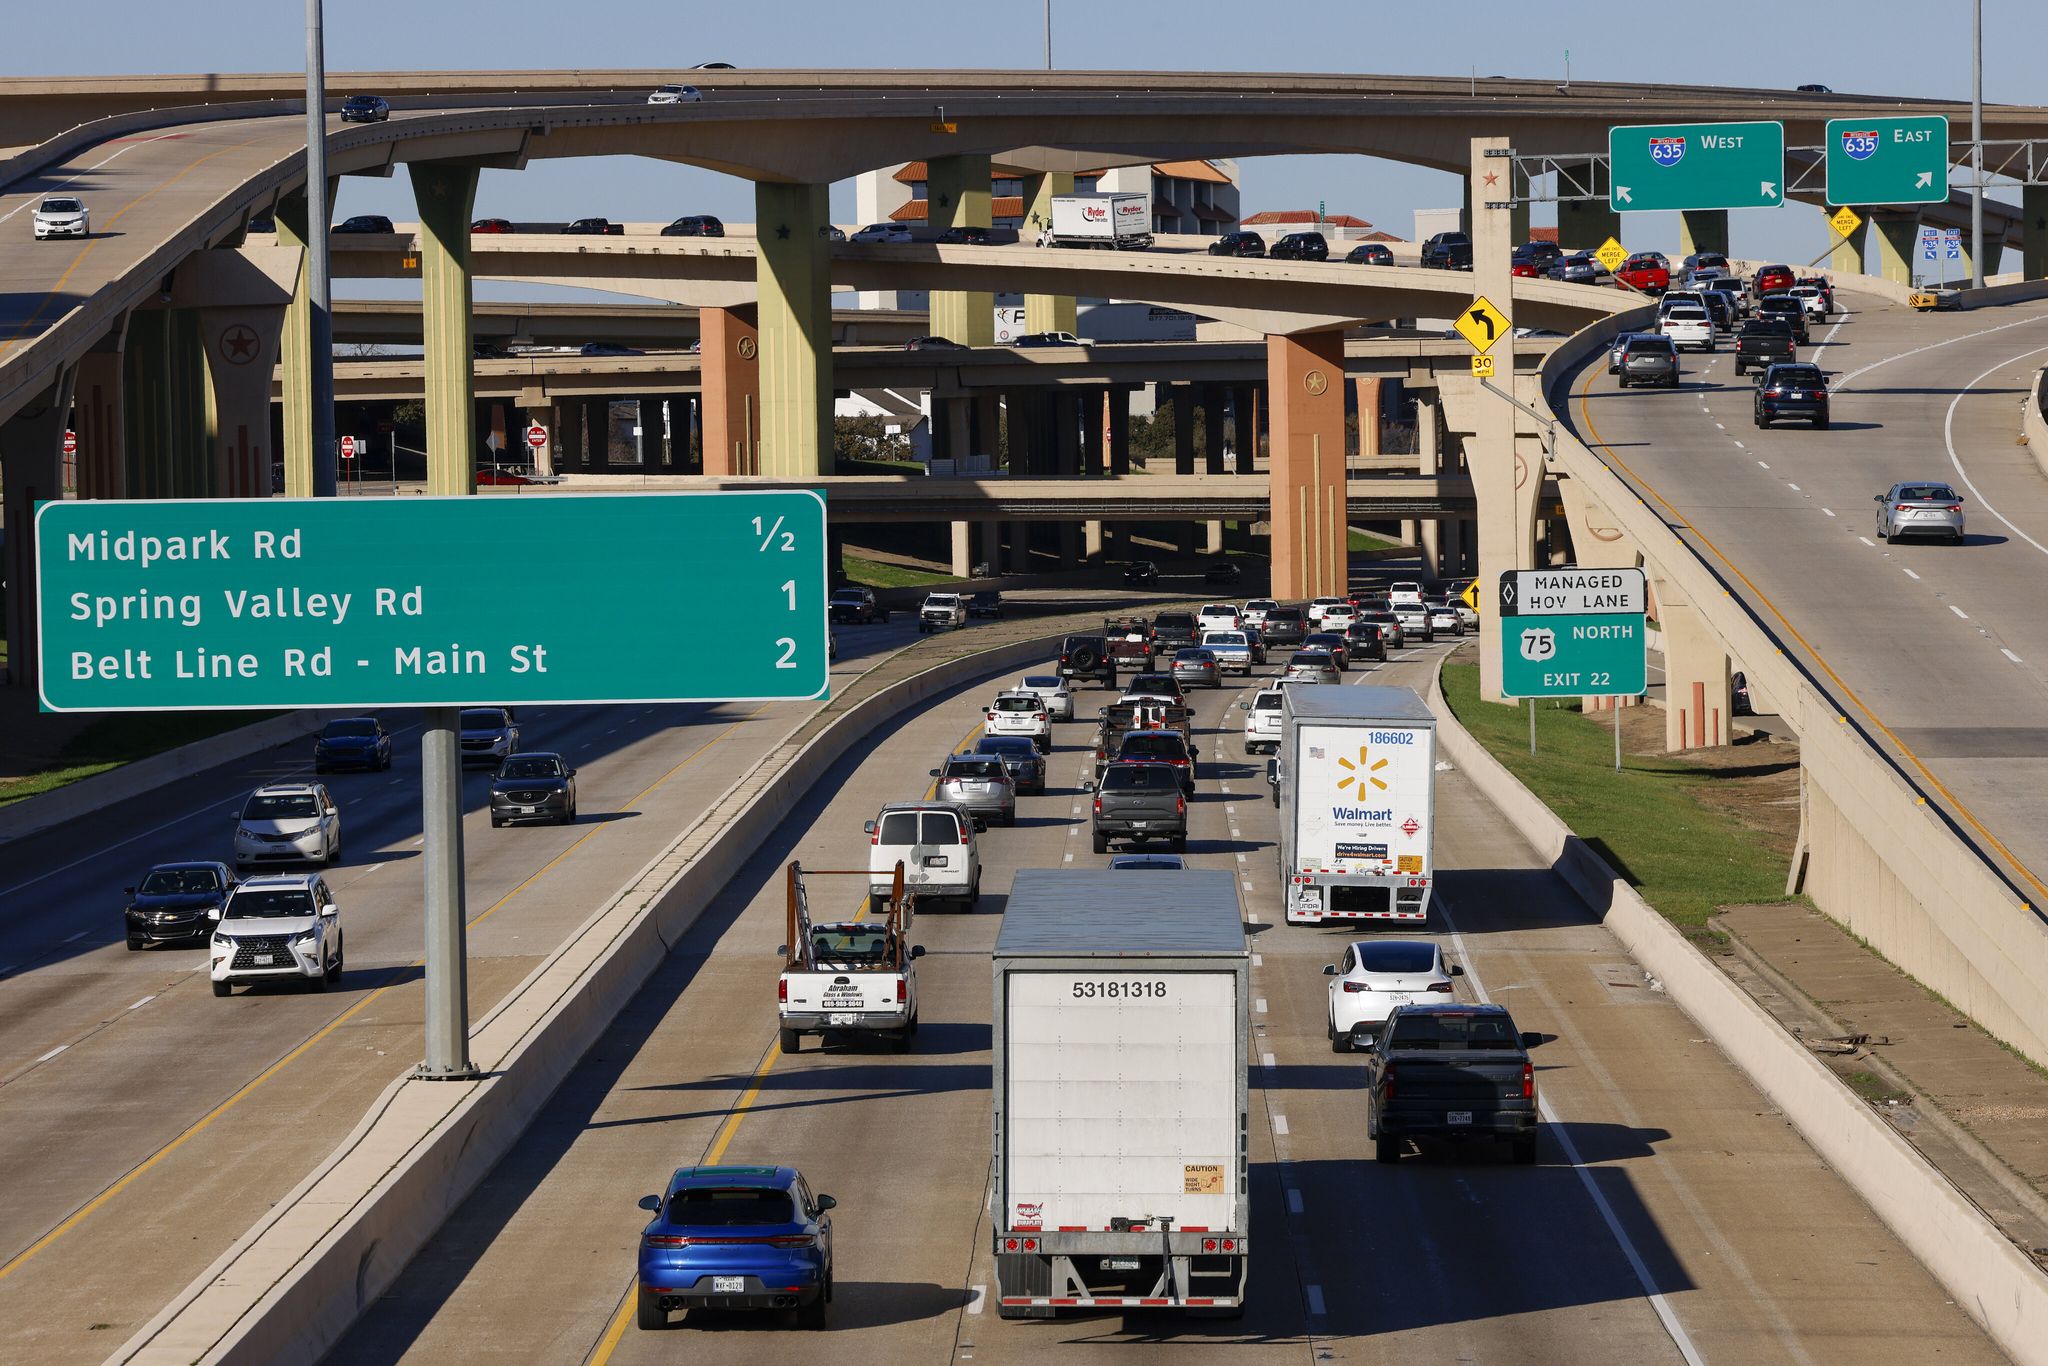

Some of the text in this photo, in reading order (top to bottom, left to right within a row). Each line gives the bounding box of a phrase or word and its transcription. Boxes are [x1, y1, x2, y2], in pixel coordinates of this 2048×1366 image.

[1701, 135, 1744, 149] WEST
[1894, 129, 1932, 143] EAST
[1653, 144, 1682, 159] 635
[1845, 138, 1875, 152] 635
[1087, 206, 1105, 218] Ryder
[1122, 206, 1142, 215] Ryder
[1474, 358, 1492, 368] 30
[68, 530, 231, 568] Midpark
[254, 528, 301, 559] Rd
[1535, 575, 1623, 589] MANAGED
[70, 580, 796, 628] Spring Valley Rd 1
[1530, 594, 1629, 609] HOV LANE
[1573, 625, 1633, 640] NORTH
[1524, 635, 1552, 654] 75
[71, 649, 152, 680] Belt
[176, 647, 259, 678] Line
[284, 646, 332, 677] Rd
[395, 643, 486, 675] Main
[510, 644, 548, 674] St
[775, 637, 797, 669] 2
[1544, 672, 1611, 687] EXIT 22
[1368, 732, 1414, 745] 186602
[1333, 807, 1392, 821] Walmart
[1072, 981, 1167, 998] 53181318
